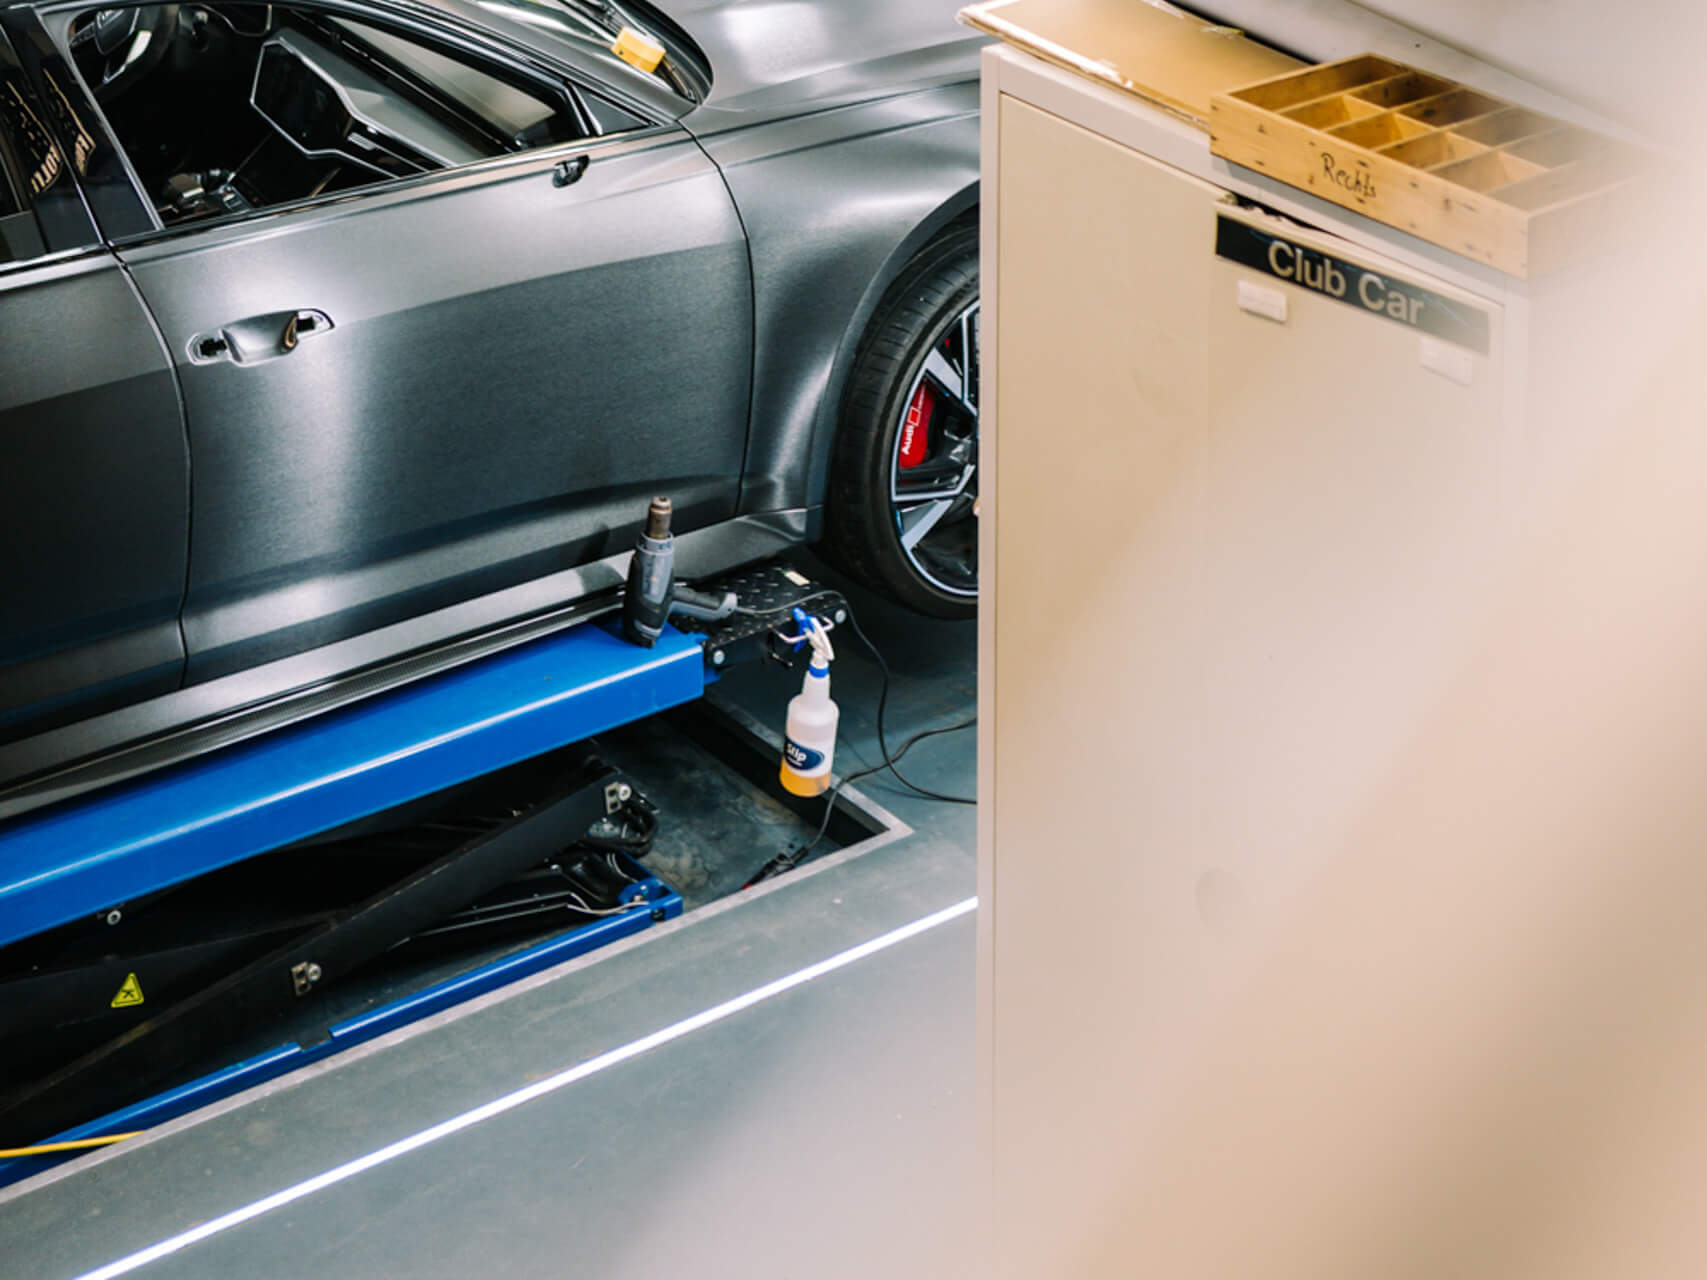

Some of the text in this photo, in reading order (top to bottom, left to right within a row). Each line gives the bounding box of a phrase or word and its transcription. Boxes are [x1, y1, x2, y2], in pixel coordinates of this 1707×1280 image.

[1320, 152, 1377, 198] Rechts
[1268, 240, 1424, 325] Club Car
[902, 426, 914, 454] Audi
